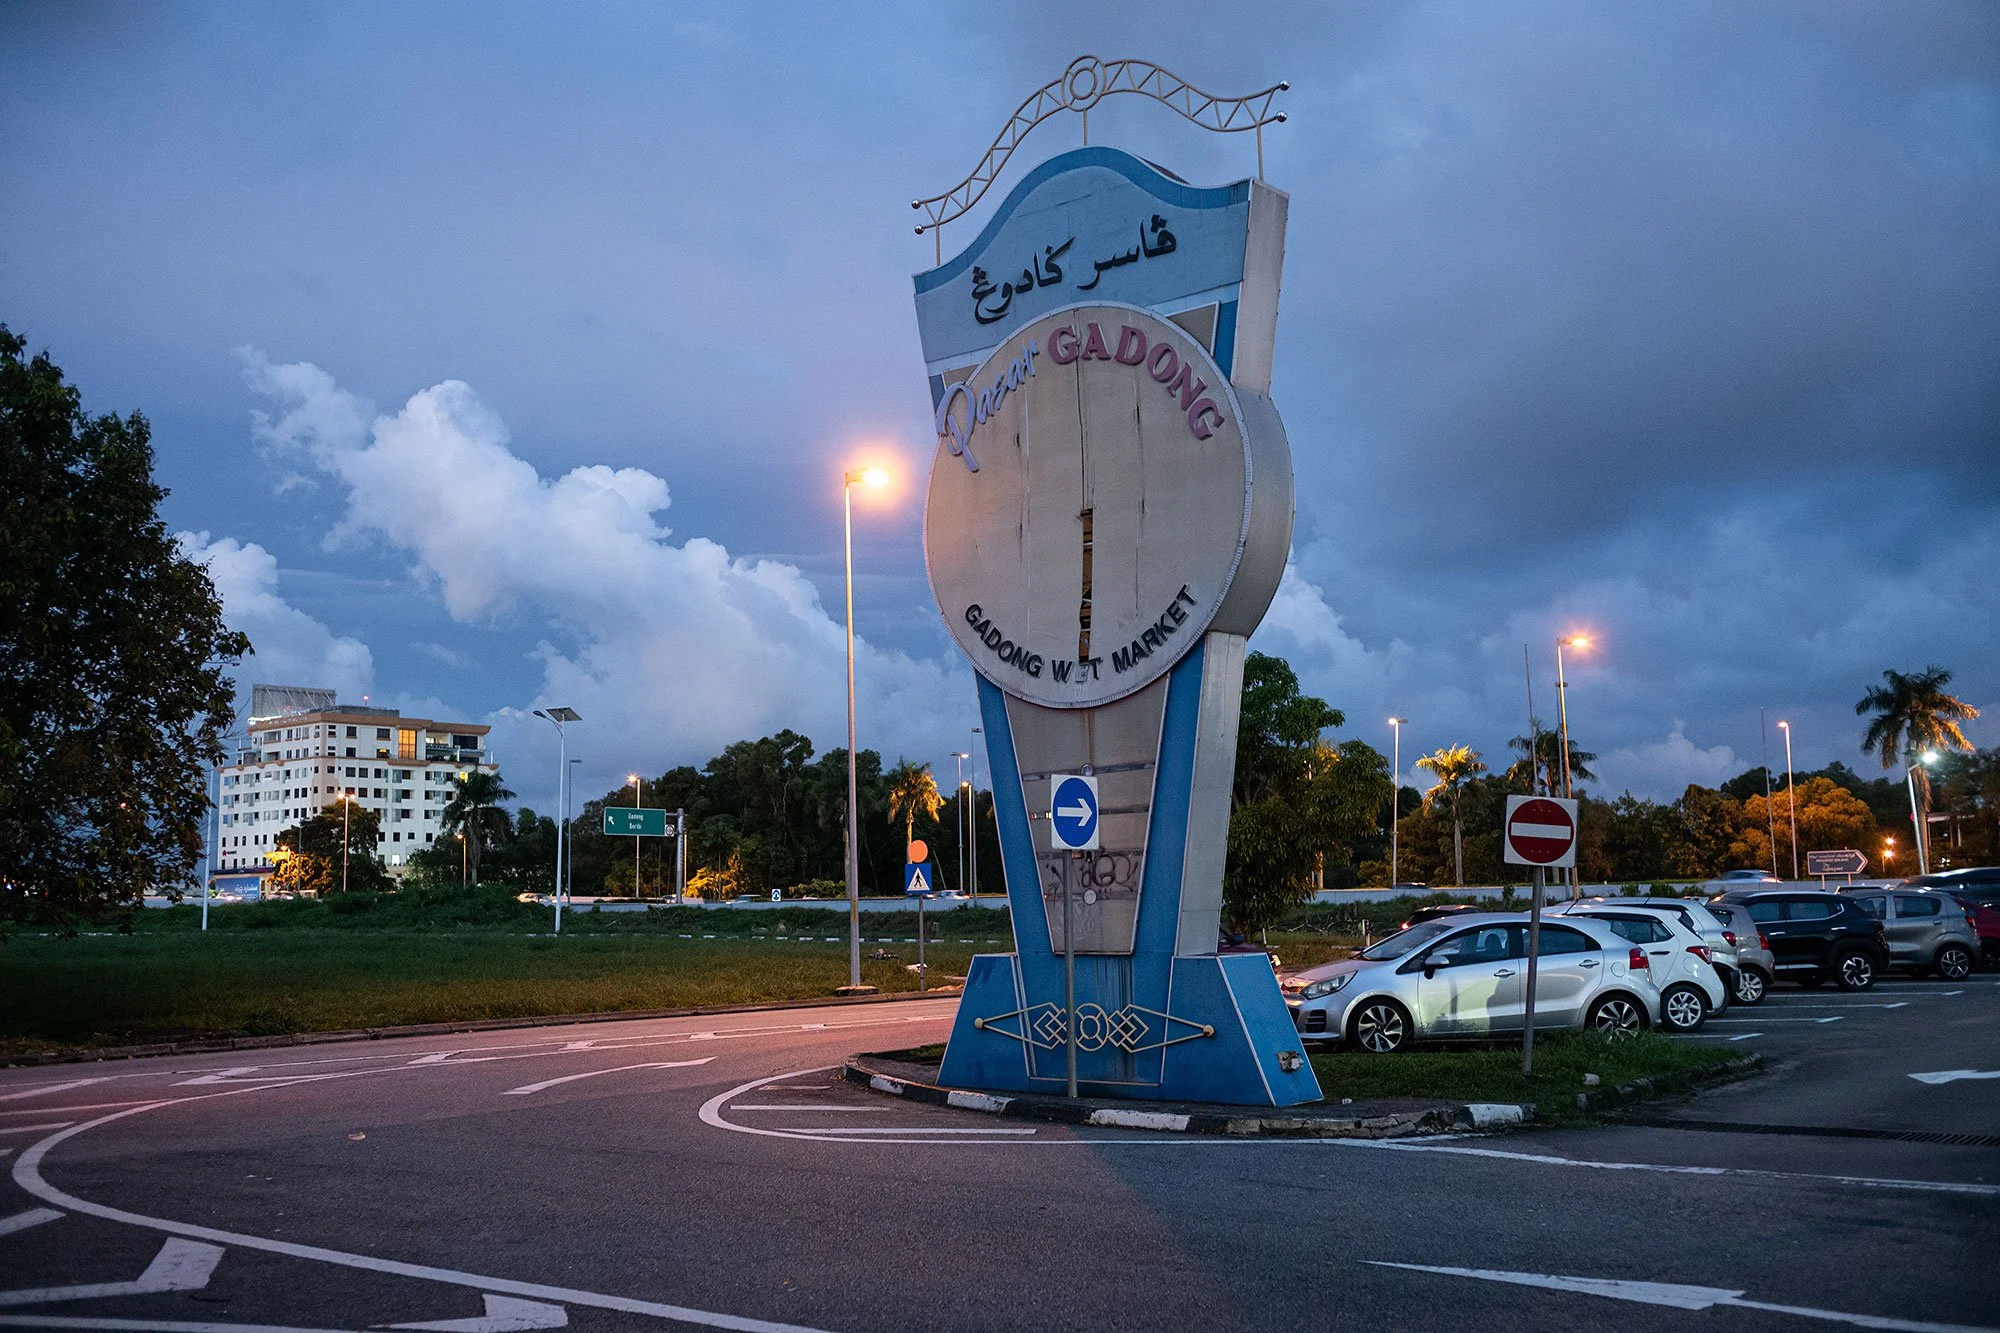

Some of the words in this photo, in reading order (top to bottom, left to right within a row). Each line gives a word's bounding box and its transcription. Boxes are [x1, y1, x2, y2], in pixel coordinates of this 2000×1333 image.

[936, 338, 1040, 473] Pasar
[1048, 323, 1225, 441] GADONG
[965, 604, 1044, 679] GADONG
[1111, 584, 1197, 673] MARKET
